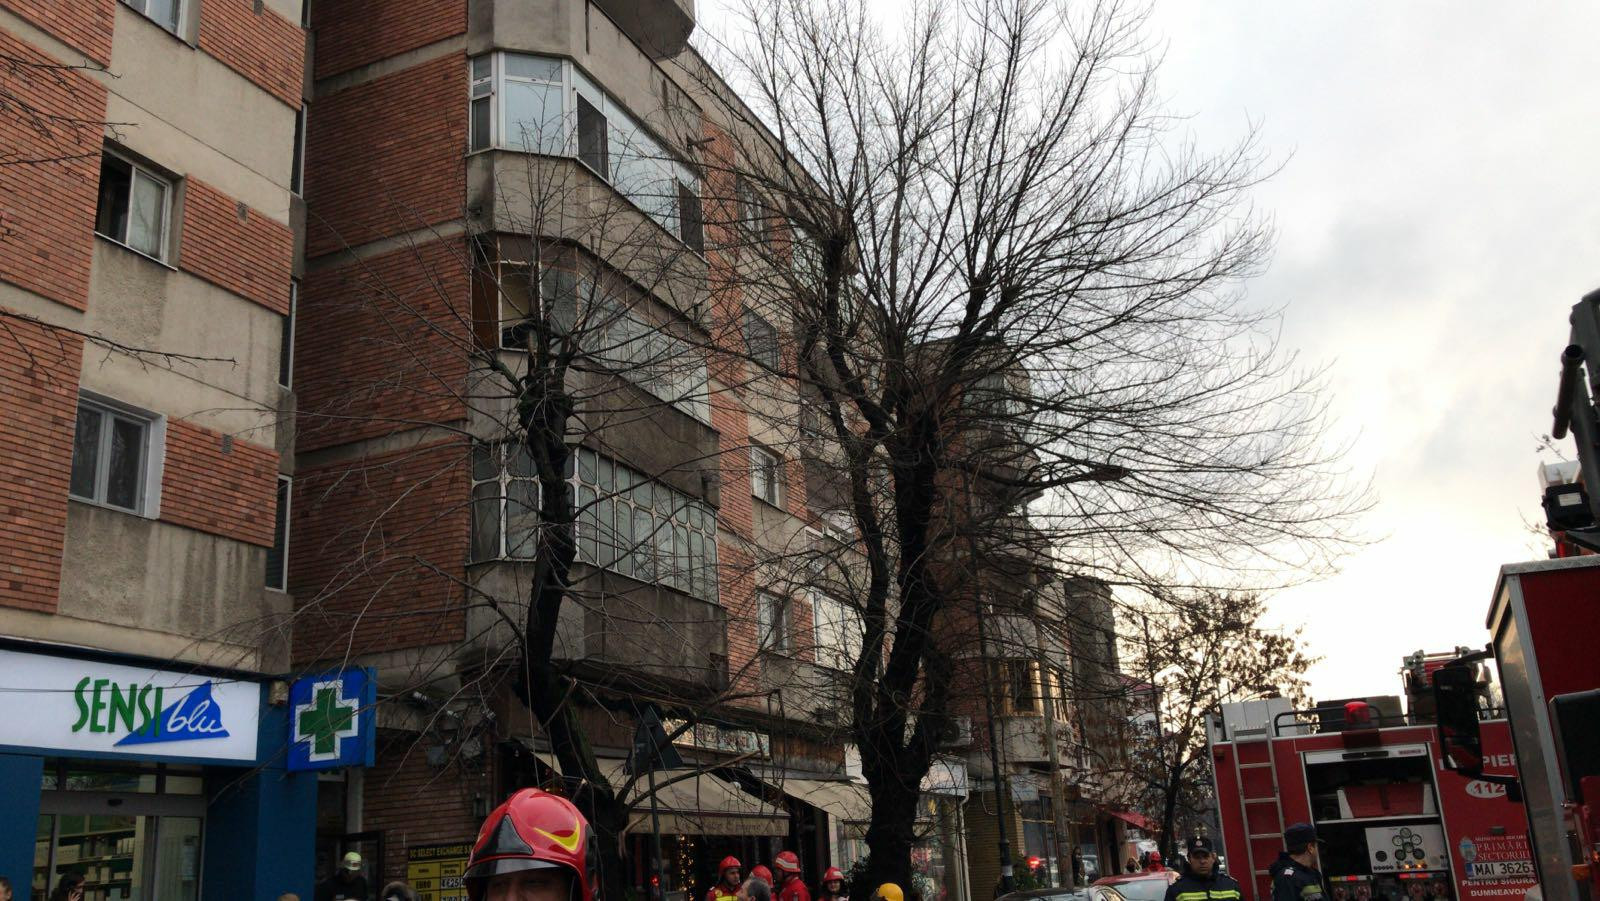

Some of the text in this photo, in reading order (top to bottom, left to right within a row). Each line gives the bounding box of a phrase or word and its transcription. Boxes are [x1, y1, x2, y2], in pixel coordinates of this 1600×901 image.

[72, 676, 227, 738] SENSI blu
[1475, 783, 1504, 793] 112
[1475, 863, 1495, 876] MAI
